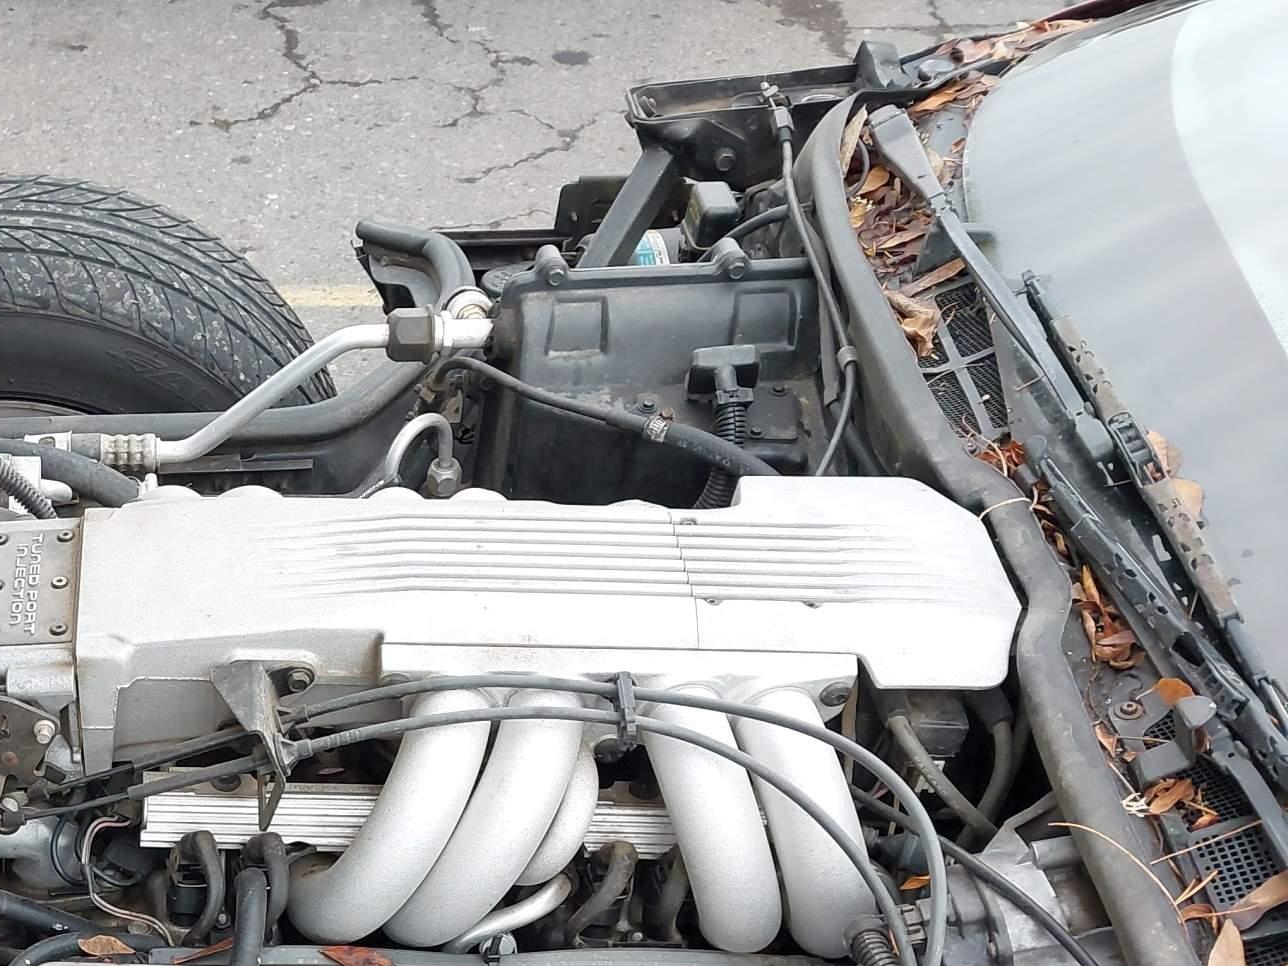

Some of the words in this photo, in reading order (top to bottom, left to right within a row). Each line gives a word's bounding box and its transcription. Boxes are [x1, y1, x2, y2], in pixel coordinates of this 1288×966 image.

[9, 543, 29, 626] INJECTION
[28, 533, 44, 587] TUNED
[23, 589, 38, 636] PORT
